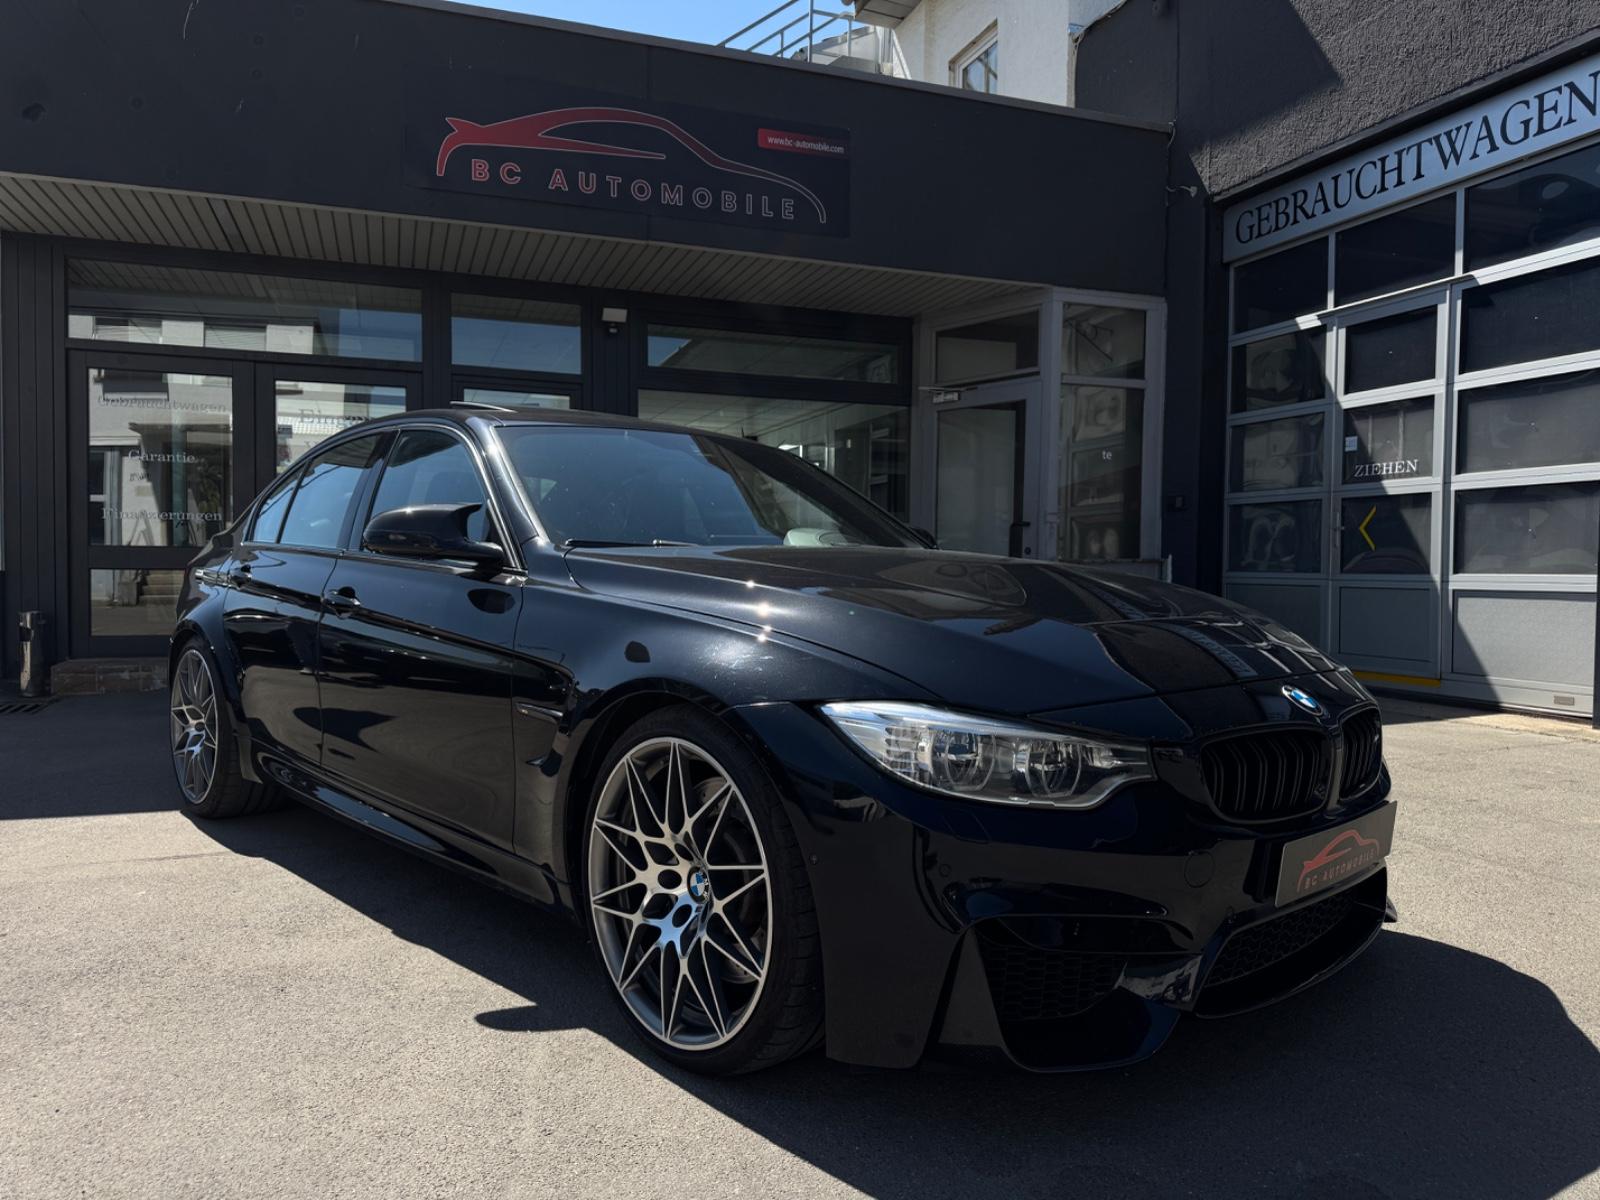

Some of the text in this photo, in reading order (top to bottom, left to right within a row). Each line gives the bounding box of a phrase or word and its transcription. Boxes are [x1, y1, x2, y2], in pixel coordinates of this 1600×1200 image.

[1235, 70, 1600, 244] GEBRAUCHTWAGEN
[470, 158, 795, 220] BC AUTOMOBILE
[127, 449, 196, 464] Garantie
[1354, 459, 1419, 478] ZIEHEN
